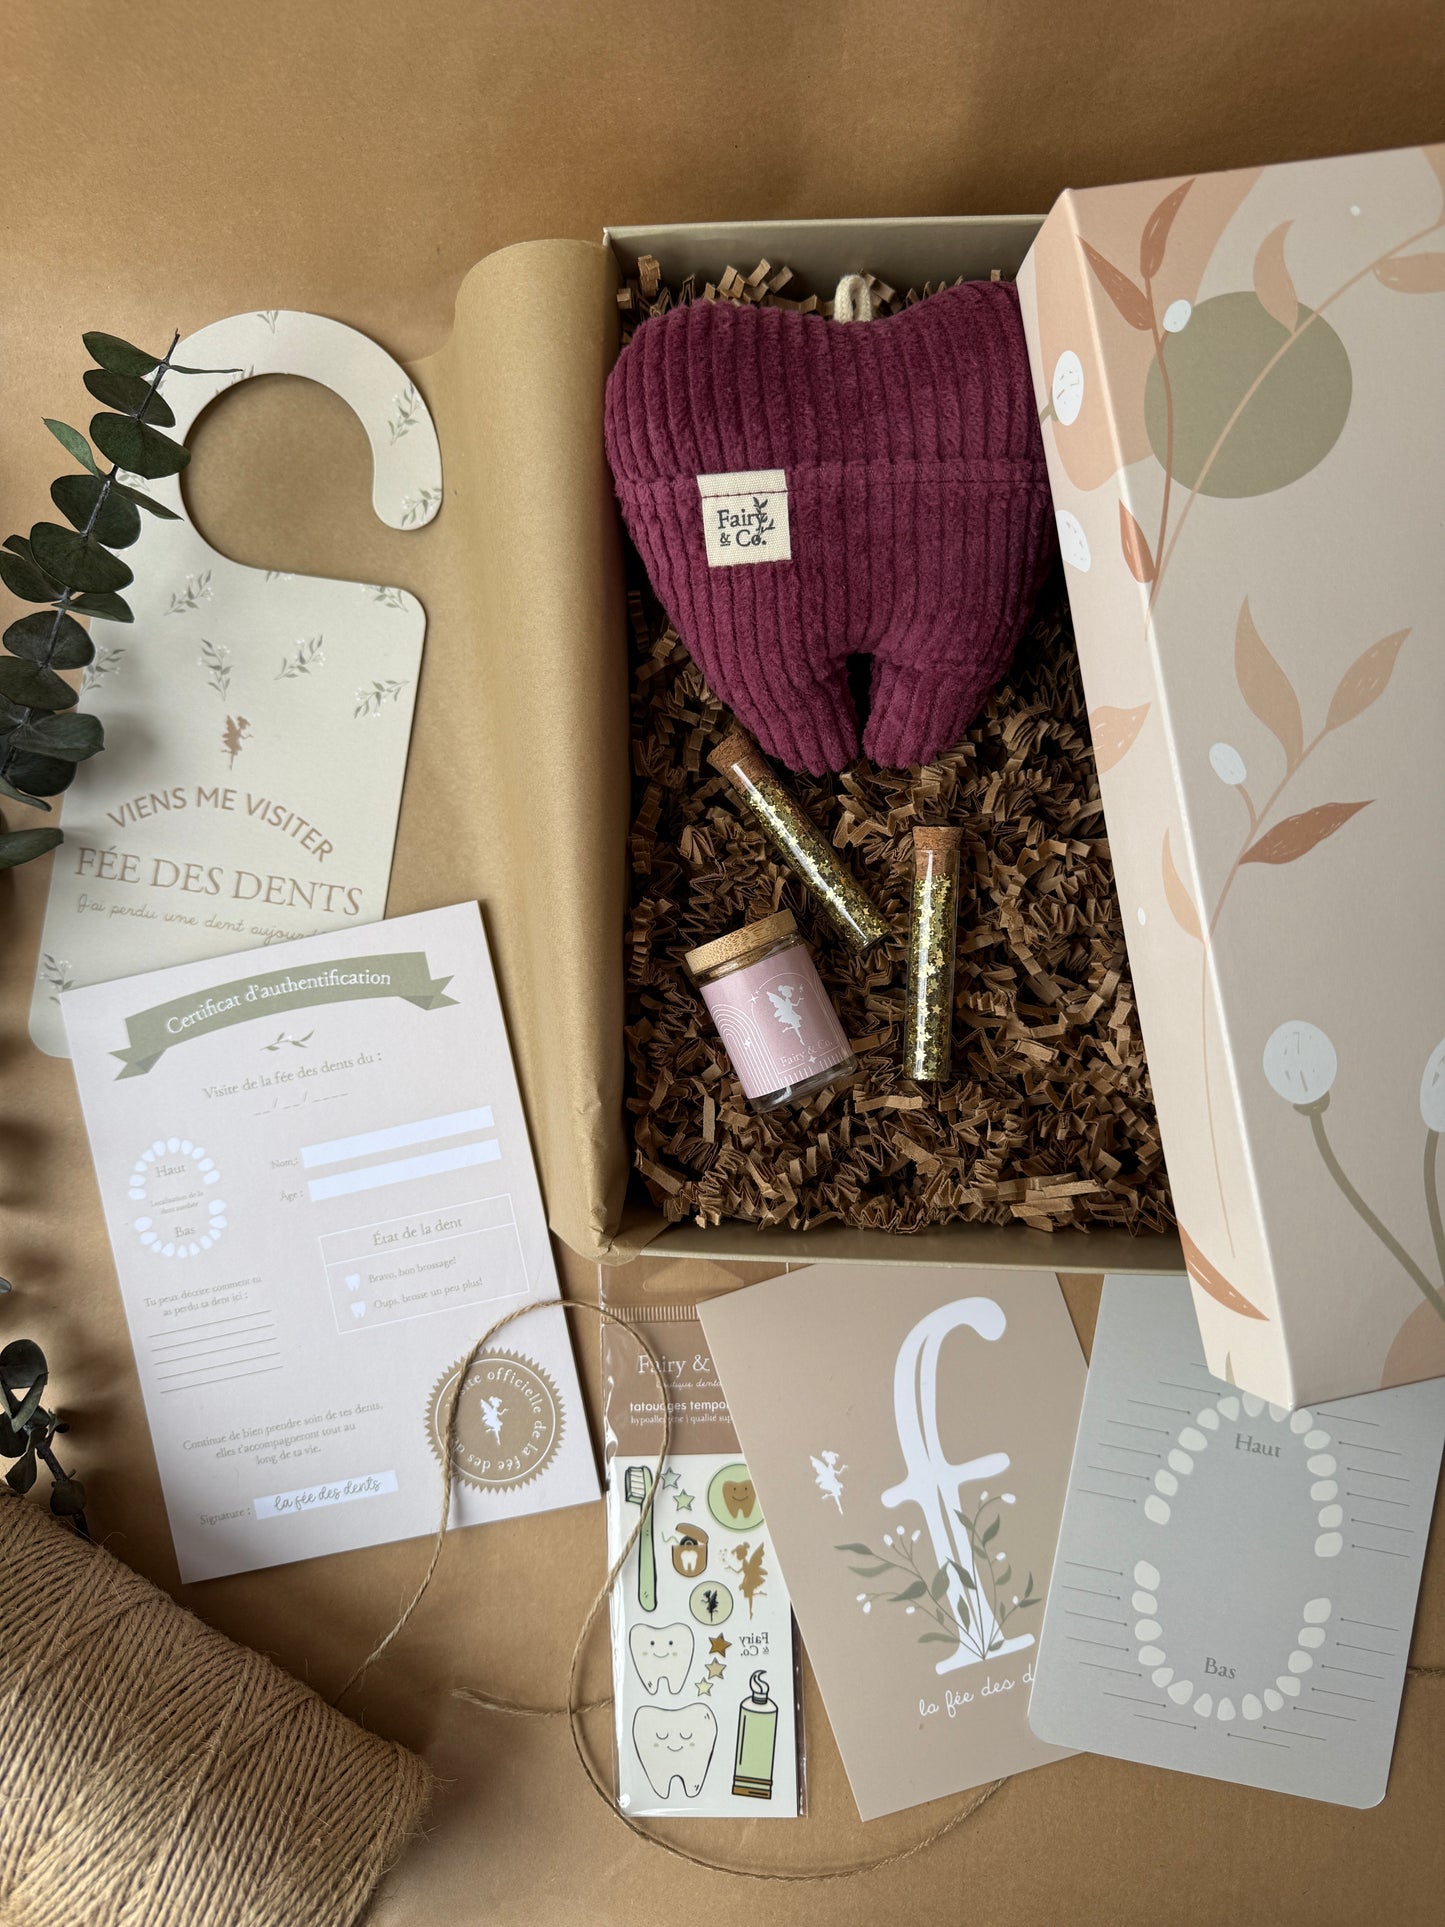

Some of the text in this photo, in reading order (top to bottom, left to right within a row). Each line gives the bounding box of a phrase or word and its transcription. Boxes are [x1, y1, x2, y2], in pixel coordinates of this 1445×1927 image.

[716, 508, 768, 531] Fairy
[719, 529, 767, 547] & Co.
[107, 786, 334, 863] VIENS ME VISITER
[74, 845, 364, 916] FÉE DES DENTS
[108, 904, 158, 918] perdu
[164, 913, 199, 926] une
[204, 914, 245, 933] dent
[166, 968, 391, 1034] Certificat d'authentification
[203, 1082, 240, 1099] Visite
[242, 1079, 258, 1091] de
[261, 1075, 272, 1087] la
[274, 1070, 295, 1085] fée
[297, 1066, 318, 1080] des
[321, 1059, 354, 1074] dents
[357, 1054, 374, 1066] du
[155, 1164, 187, 1178] Haut
[174, 1226, 197, 1238] Bas
[372, 1217, 463, 1246] État de la dent
[398, 1267, 416, 1277] bon
[416, 1256, 457, 1273] brossage!
[143, 1297, 157, 1308] Tu
[211, 1278, 251, 1292] comment
[401, 1291, 430, 1303] brosse
[430, 1288, 442, 1297] un
[444, 1284, 461, 1296] peu
[462, 1276, 483, 1292] plus!
[163, 1309, 173, 1317] as
[174, 1301, 199, 1317] perdu
[210, 1296, 230, 1306] dent
[231, 1291, 243, 1303] ici
[692, 1354, 711, 1372] &
[487, 1367, 544, 1414] officielle
[182, 1436, 227, 1451] Continue
[229, 1430, 241, 1442] de
[243, 1426, 264, 1438] bien
[265, 1418, 302, 1437] prendre
[303, 1412, 323, 1425] soin
[325, 1409, 338, 1421] de
[339, 1408, 353, 1417] tes
[215, 1446, 237, 1459] elles
[322, 1425, 342, 1437] tout
[343, 1422, 356, 1432] au
[532, 1420, 547, 1439] de
[256, 1444, 322, 1466] long de ta vie.
[522, 1442, 539, 1456] la
[1234, 1432, 1282, 1458] Haut
[467, 1453, 492, 1474] des
[199, 1509, 245, 1526] Signature
[274, 1495, 294, 1511] la
[294, 1492, 316, 1511] fée
[317, 1485, 341, 1501] des
[343, 1476, 382, 1495] dents
[1203, 1656, 1237, 1680] Bas
[919, 1698, 940, 1717] la
[945, 1689, 975, 1718] fée
[980, 1676, 1015, 1697] des
